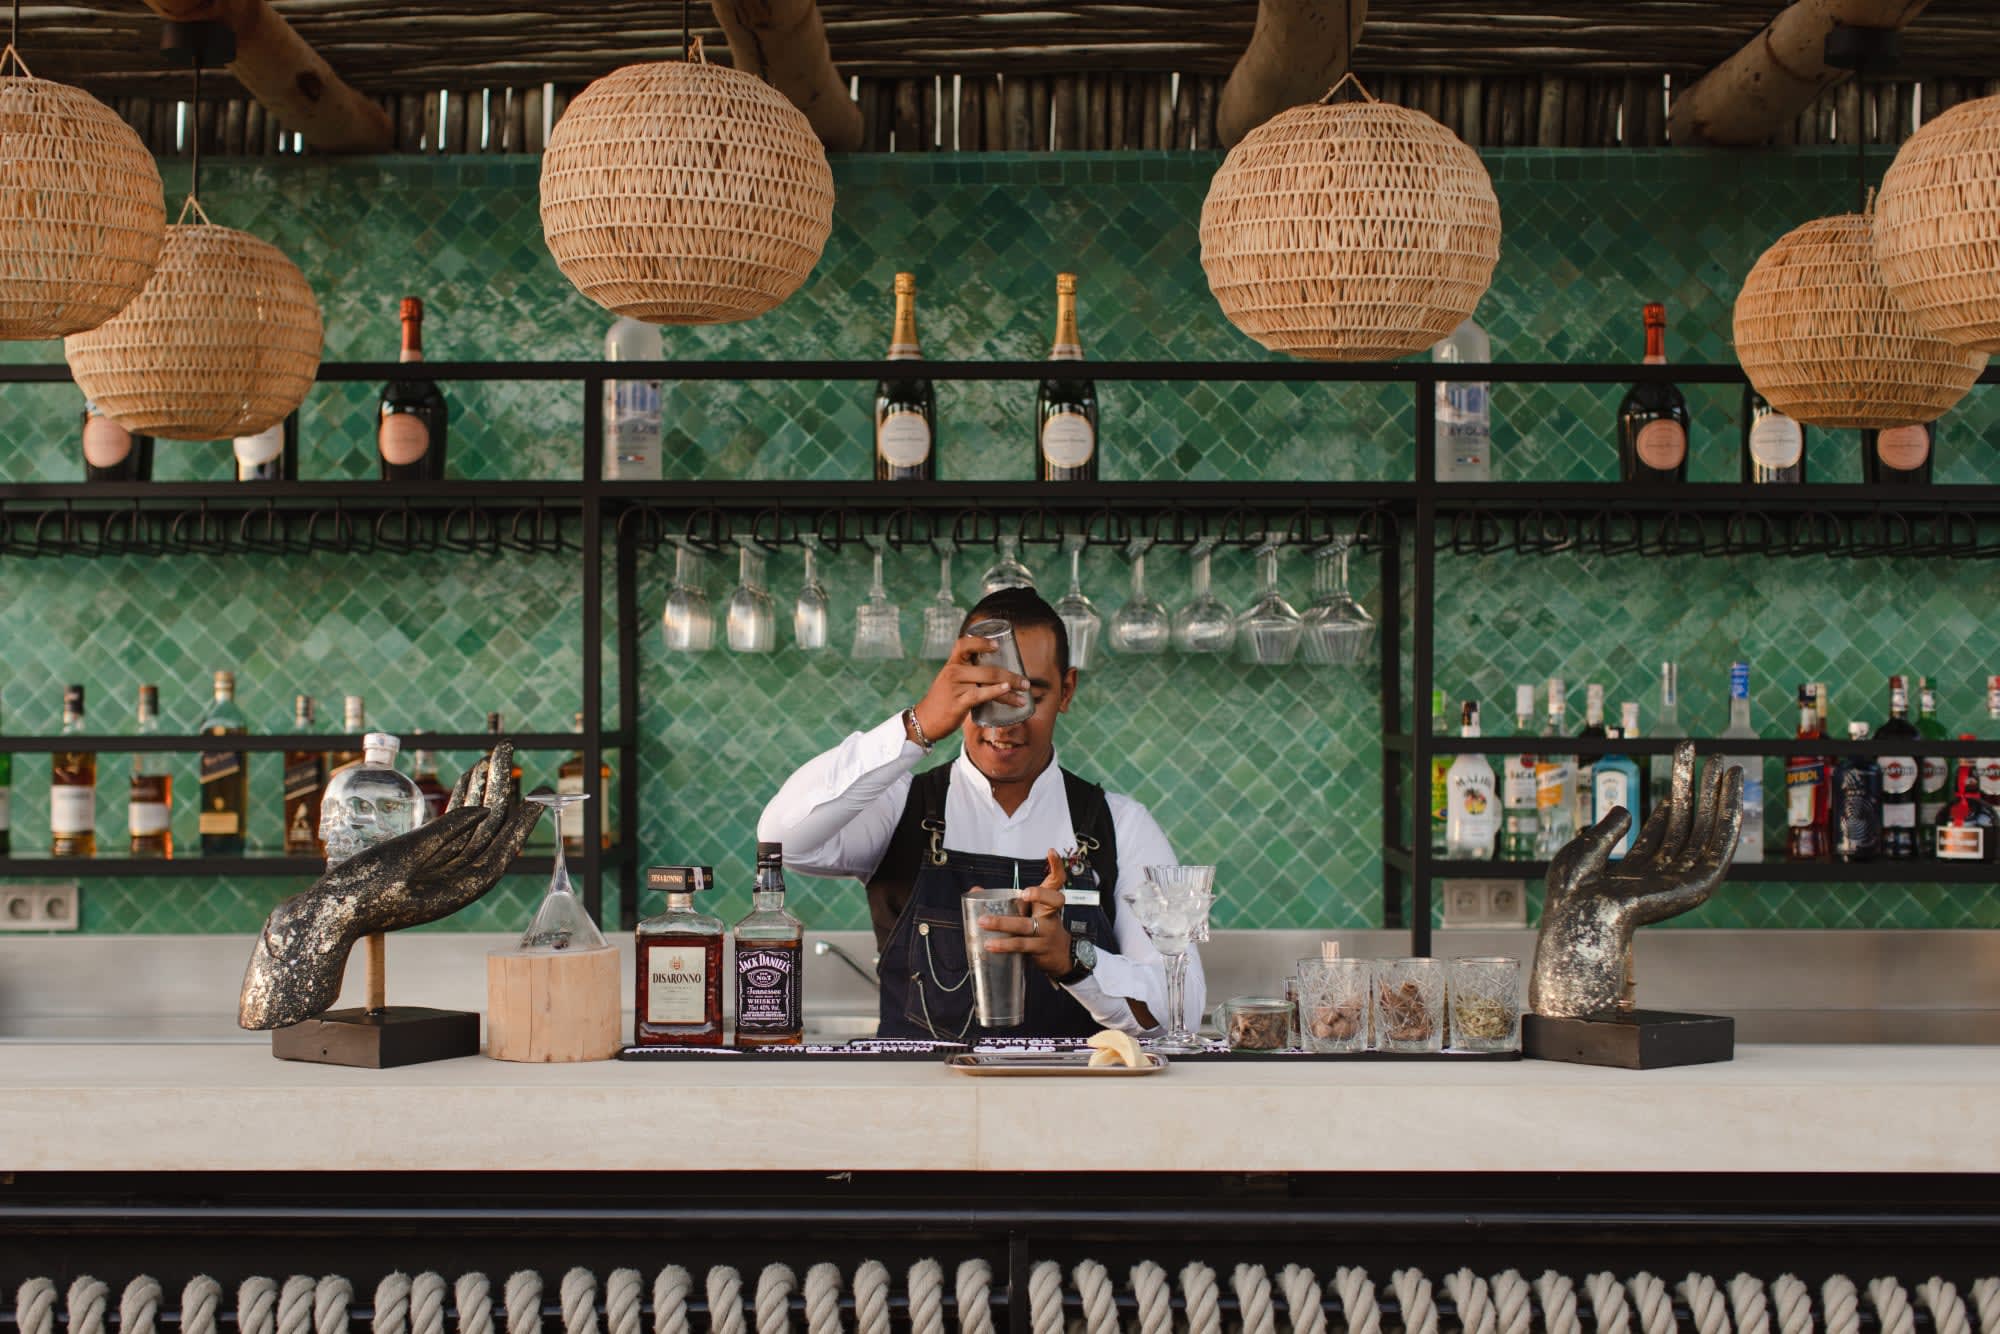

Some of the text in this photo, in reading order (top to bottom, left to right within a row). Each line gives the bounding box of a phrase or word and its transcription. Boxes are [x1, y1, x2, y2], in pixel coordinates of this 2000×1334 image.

[739, 953, 792, 974] JACK DANIEL'S
[652, 973, 702, 984] DISARONNO
[747, 986, 782, 995] Tennessee
